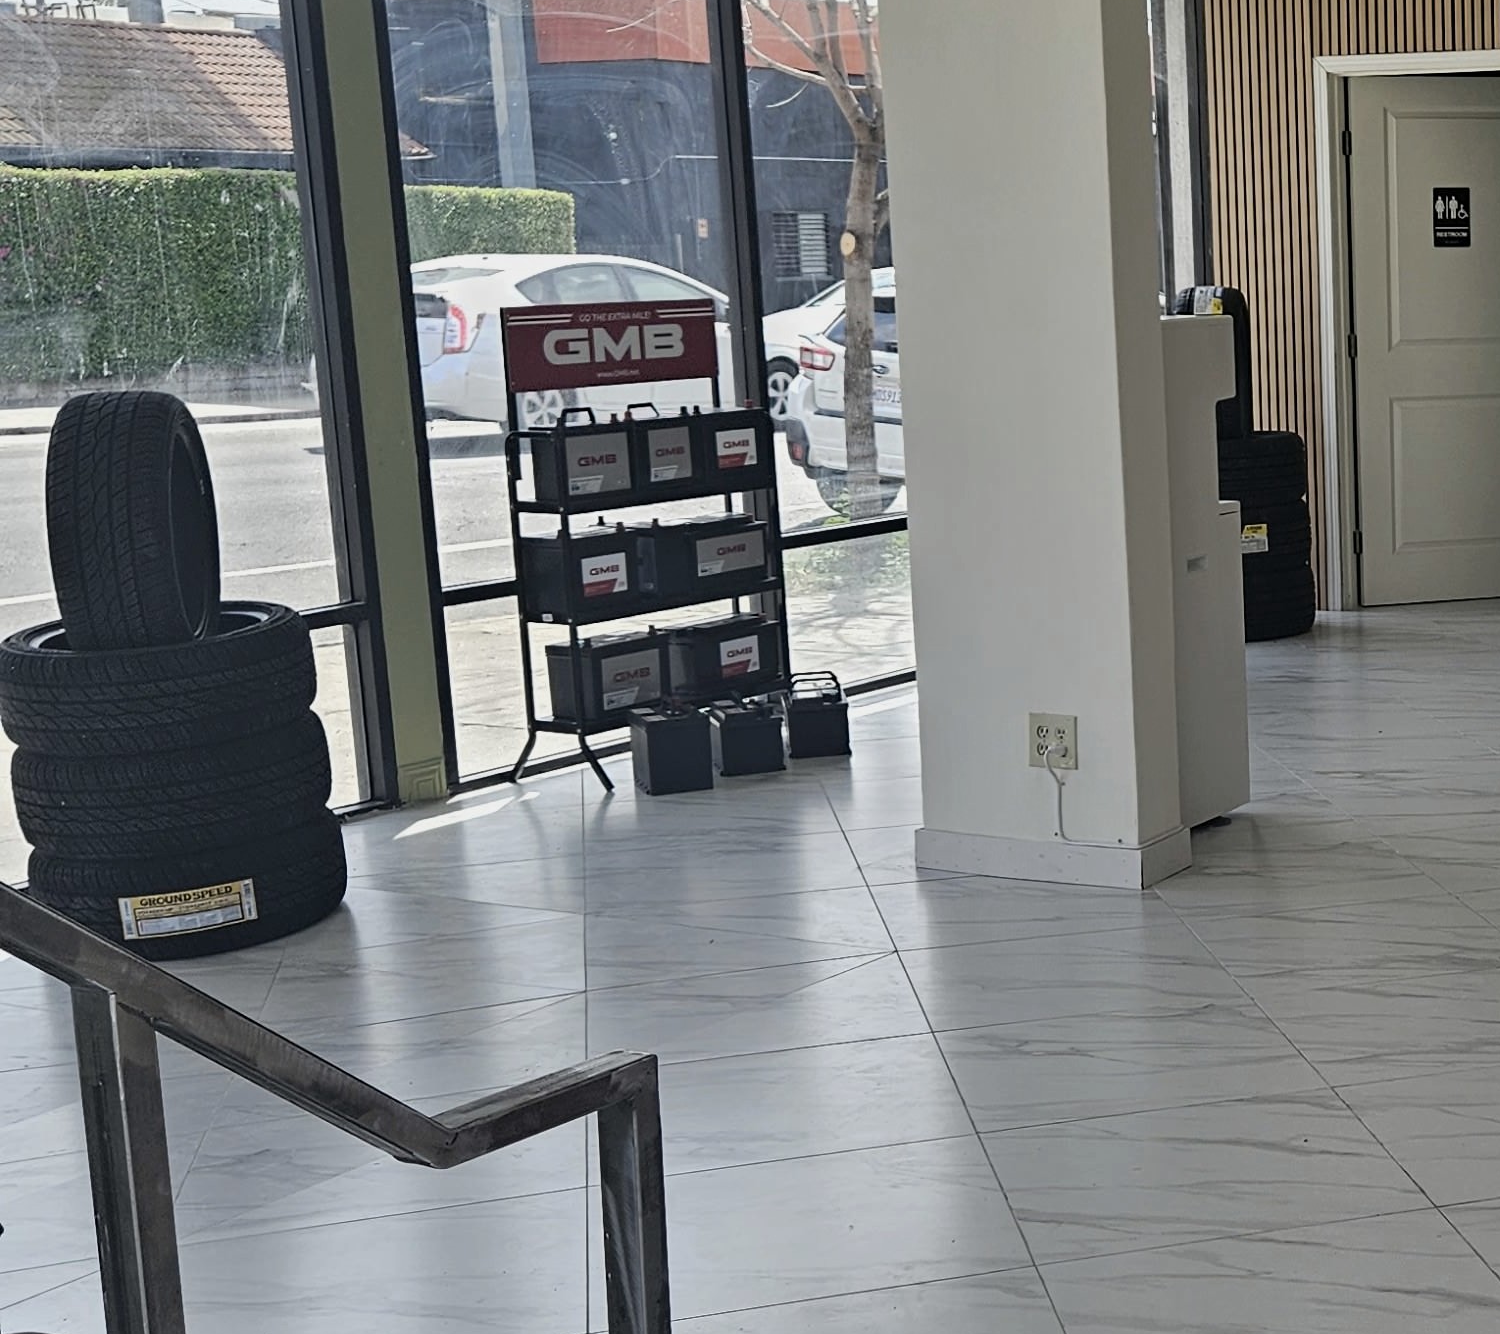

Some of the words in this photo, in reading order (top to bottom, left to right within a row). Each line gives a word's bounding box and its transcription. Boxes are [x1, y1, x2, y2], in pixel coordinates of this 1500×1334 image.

[579, 313, 591, 322] GO
[592, 312, 608, 321] THE
[608, 311, 631, 321] EXTRA
[543, 323, 685, 365] GMB
[723, 439, 750, 449] GMB
[655, 446, 685, 458] GMB
[577, 453, 617, 467] GMB
[716, 543, 746, 556] GMB
[589, 564, 620, 576] GMB
[726, 646, 753, 658] GMB
[613, 667, 651, 683] GMB
